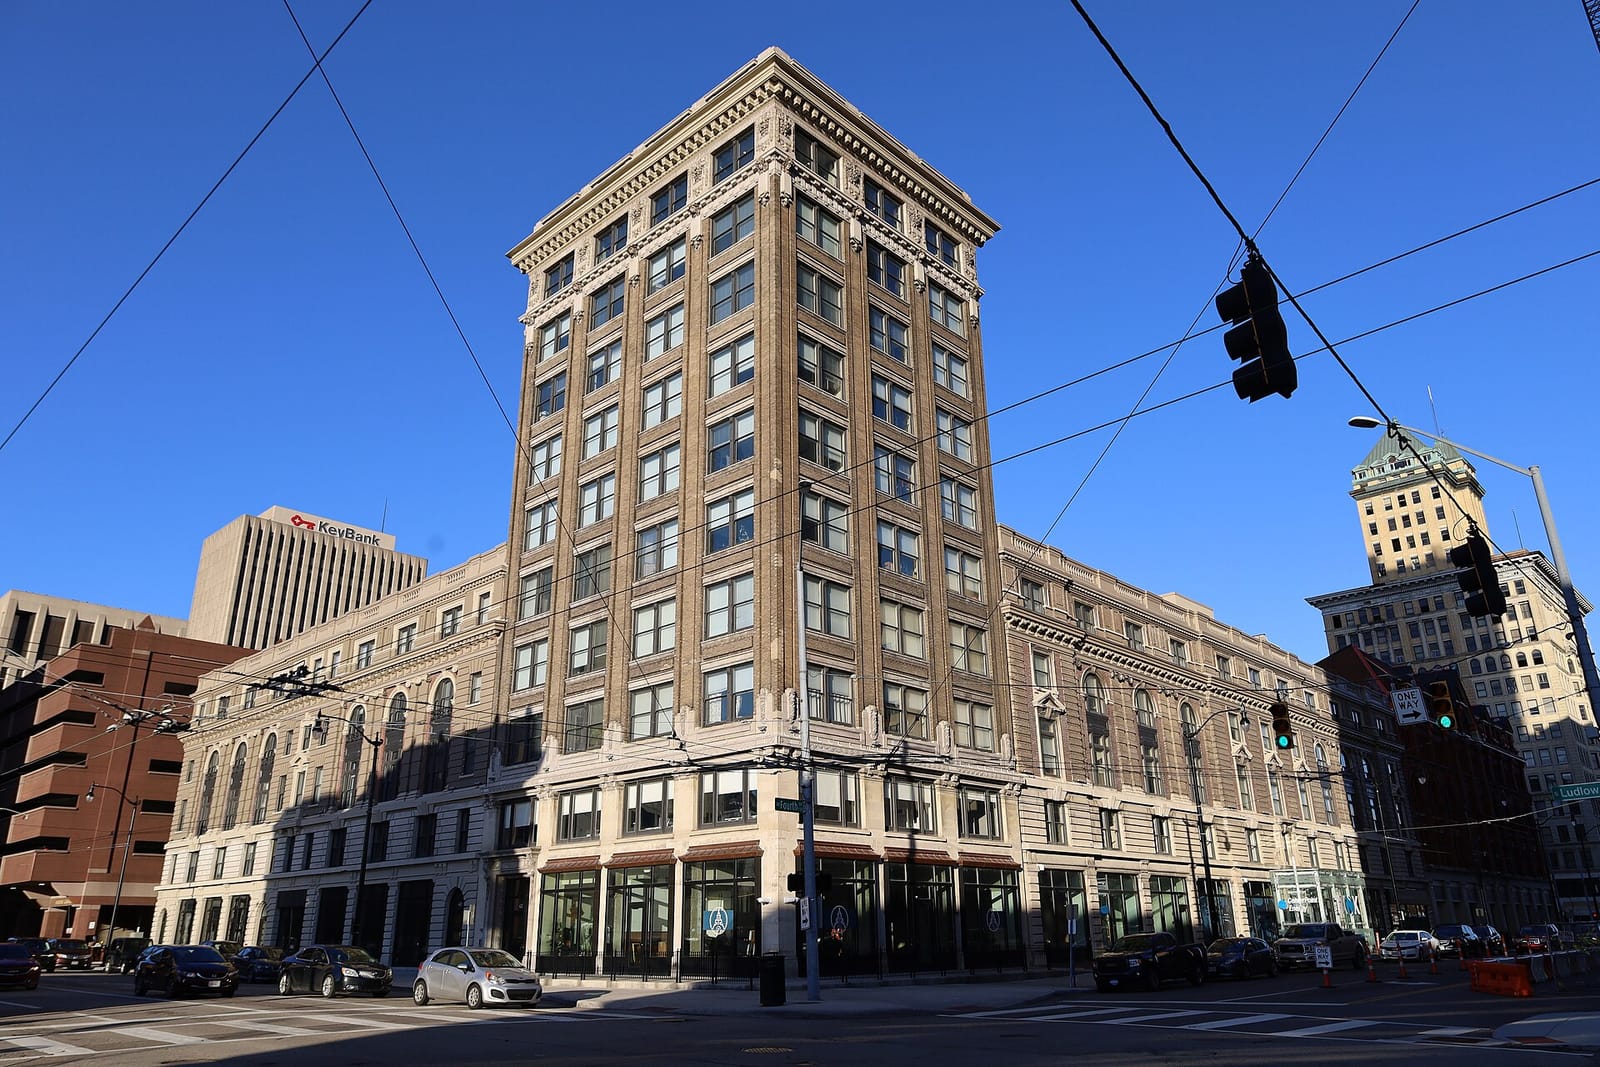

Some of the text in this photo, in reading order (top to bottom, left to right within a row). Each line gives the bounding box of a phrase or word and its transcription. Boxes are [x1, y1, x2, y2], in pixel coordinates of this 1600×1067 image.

[319, 521, 380, 546] KeyBank
[1397, 690, 1417, 701] ONE
[1398, 699, 1419, 710] WAY
[1560, 786, 1599, 798] Ludlow
[1318, 952, 1329, 960] WAY
